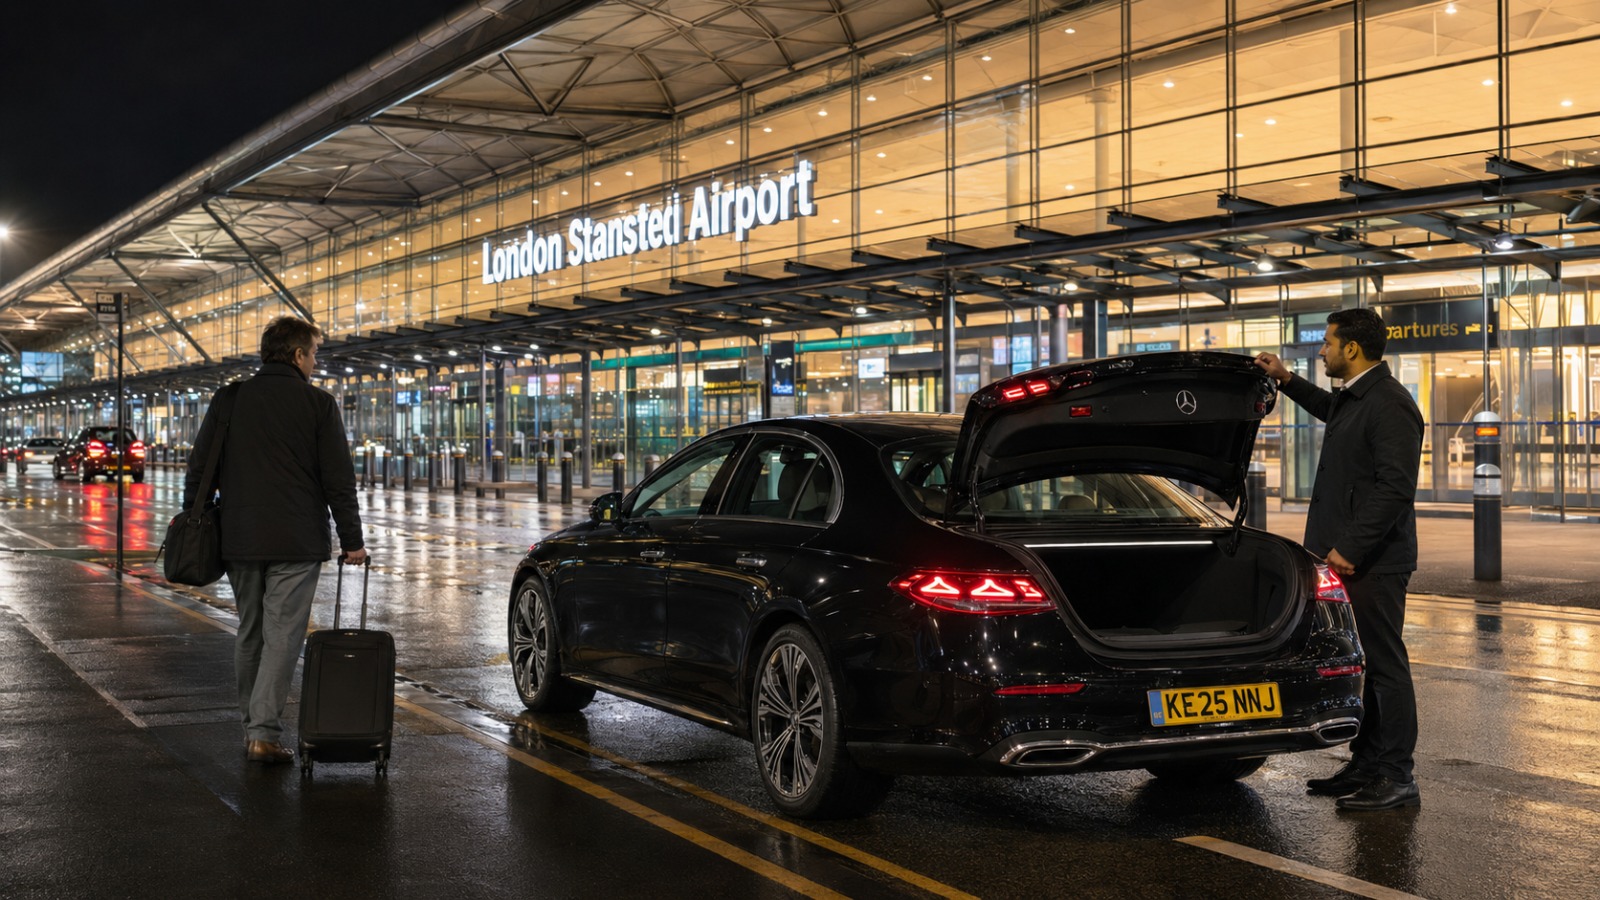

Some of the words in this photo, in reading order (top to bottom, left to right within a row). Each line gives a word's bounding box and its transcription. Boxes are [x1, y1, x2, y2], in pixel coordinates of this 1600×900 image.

[482, 230, 565, 285] London
[568, 192, 681, 267] Stansted
[688, 159, 815, 242] Airport
[1164, 690, 1229, 719] KE25
[1233, 686, 1276, 714] NNJ
